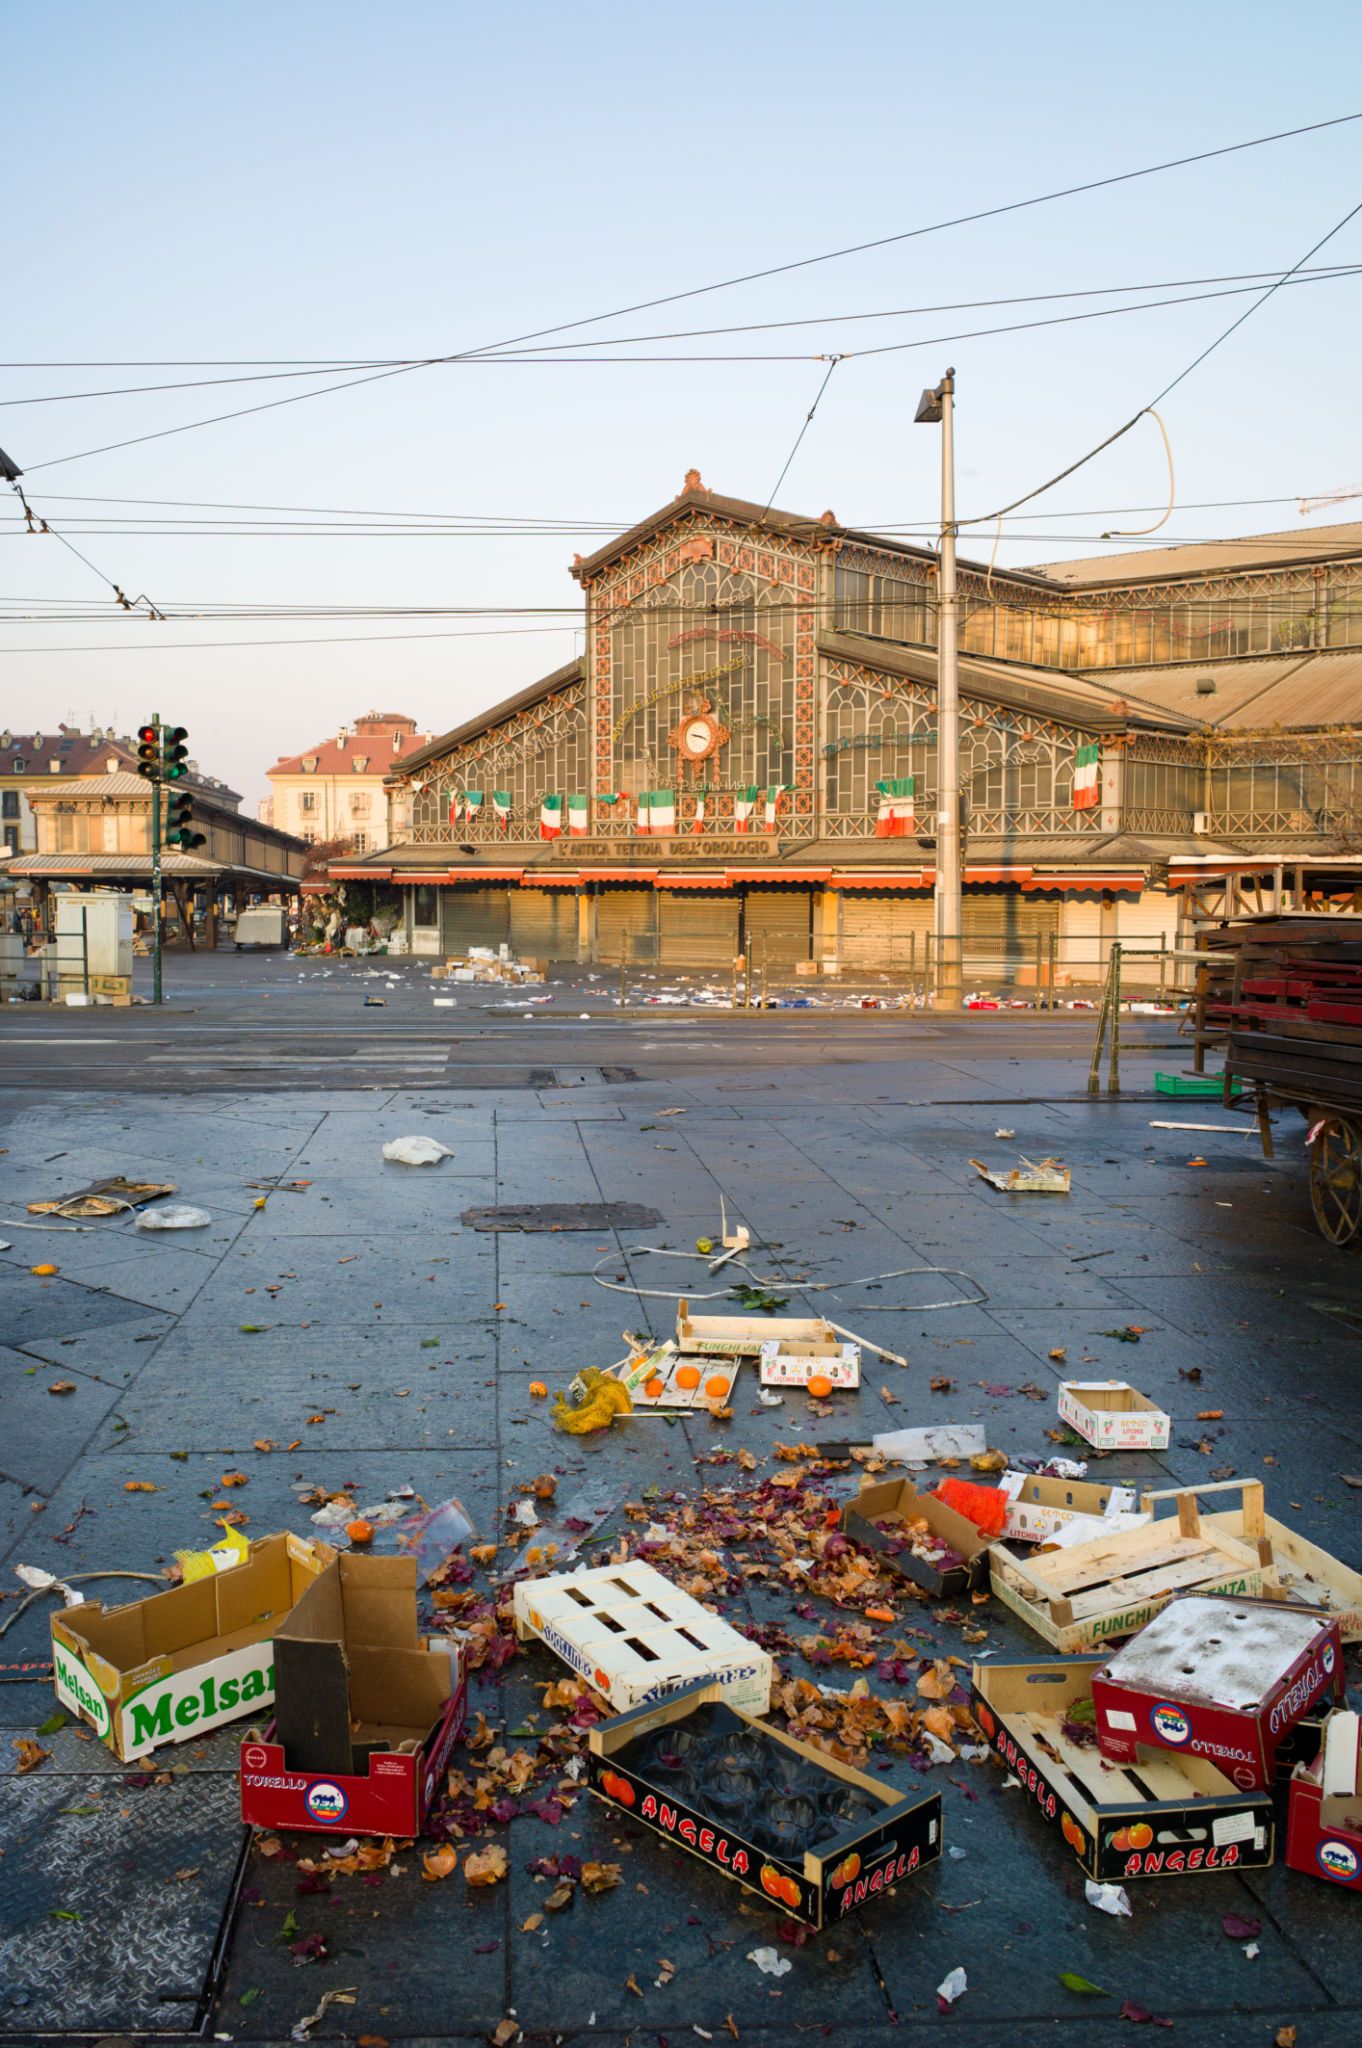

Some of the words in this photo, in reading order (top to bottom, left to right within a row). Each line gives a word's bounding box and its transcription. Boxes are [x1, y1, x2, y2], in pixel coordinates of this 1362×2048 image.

[558, 842, 611, 857] L'ANTICA
[614, 842, 663, 856] TETTOIA
[669, 840, 770, 856] DELL'OROLOGIO
[696, 1341, 741, 1352] FUNGHI
[1009, 1529, 1039, 1541] LITCHIS
[1092, 1607, 1151, 1638] FUNGHI
[56, 1656, 104, 1723] Melsan
[1269, 1660, 1323, 1735] TORELLO
[1190, 1739, 1257, 1764] TORELLO
[243, 1774, 307, 1790] TORELLO
[997, 1730, 1056, 1818] ANGELA
[641, 1795, 749, 1875] ANGELA
[1124, 1844, 1239, 1876] ANGELA
[840, 1846, 920, 1912] ANGELA
